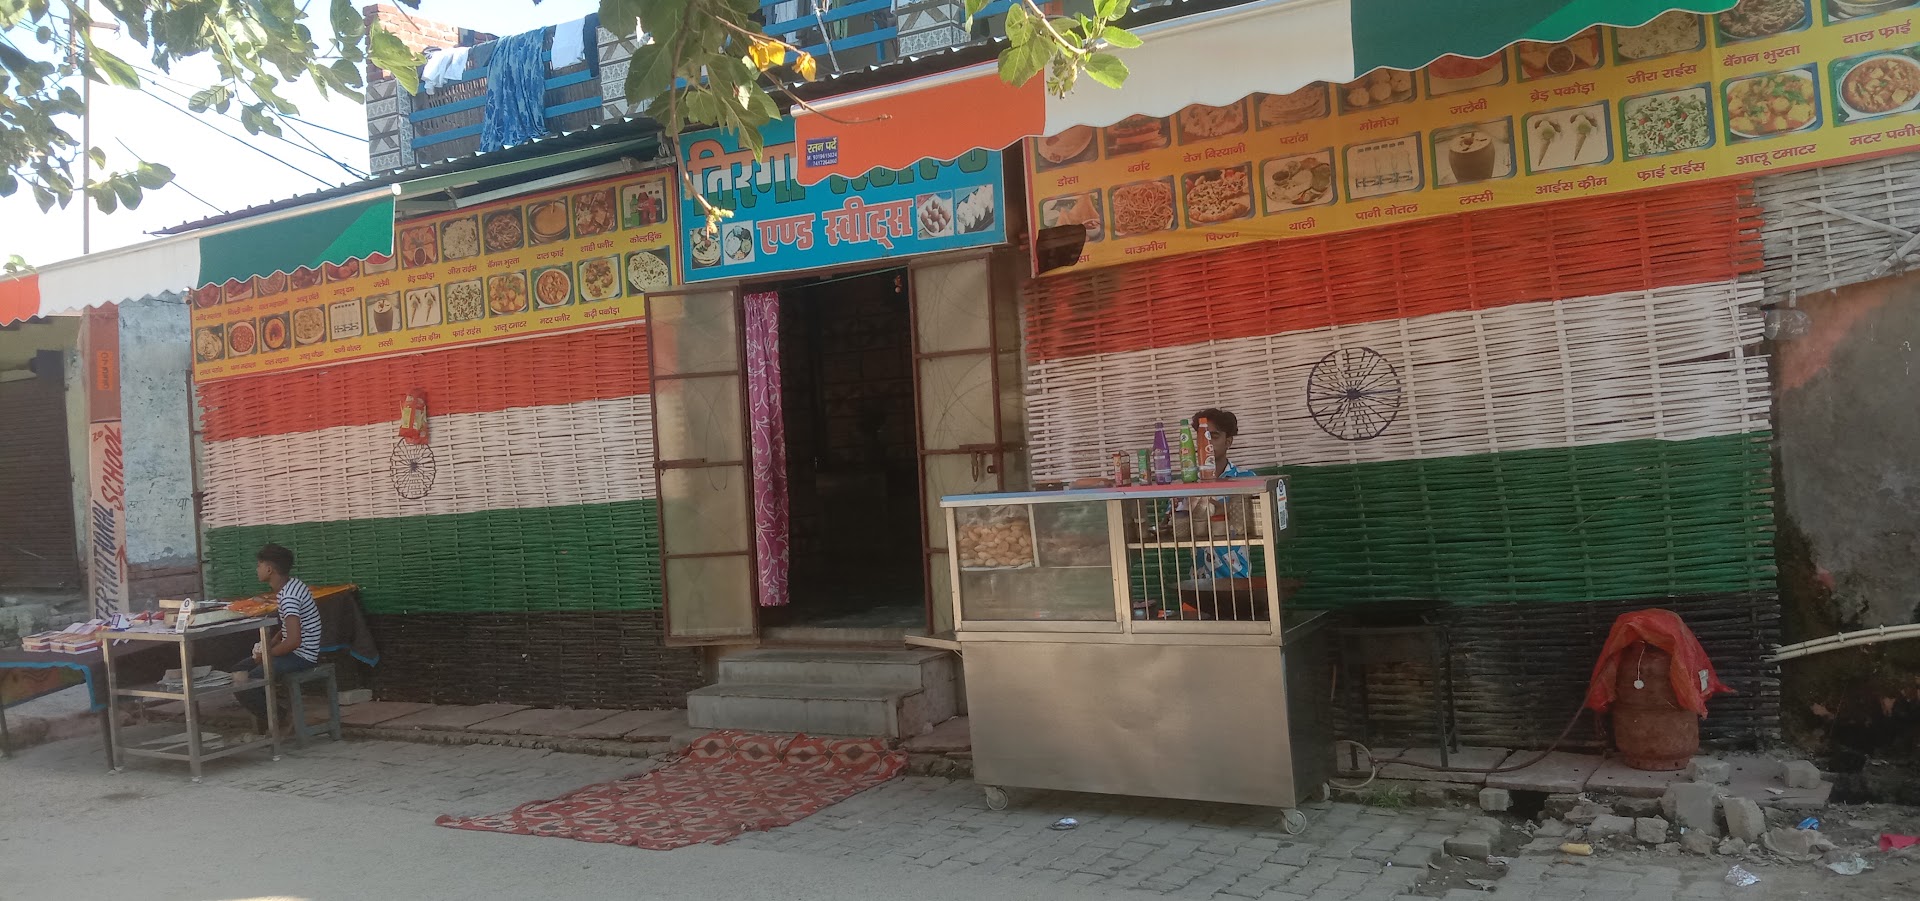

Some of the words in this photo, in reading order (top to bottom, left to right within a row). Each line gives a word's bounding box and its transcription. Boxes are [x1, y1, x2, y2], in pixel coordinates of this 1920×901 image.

[1843, 30, 1874, 44] दाल
[1879, 19, 1912, 39] फ्राई
[1764, 45, 1800, 64] भुरता
[1626, 71, 1658, 84] जीरा
[1662, 62, 1697, 78] राईस
[1450, 98, 1488, 115] जलेबी
[1360, 117, 1399, 132] मोमोज
[807, 142, 824, 153] रतन
[825, 137, 838, 150] पर्दे
[1849, 132, 1882, 146] मटर
[1183, 151, 1201, 163] वेज
[1736, 151, 1772, 166] आलू
[1772, 144, 1816, 160] टमाटर
[1127, 161, 1151, 174] बर्गर
[1637, 163, 1666, 181] फ्राई
[1669, 161, 1706, 176] राईस
[1057, 174, 1079, 187] डोसा
[1535, 179, 1574, 194] आईस
[1577, 175, 1608, 190] क्रीम
[1459, 190, 1494, 205] लस्सी
[1355, 206, 1381, 221] पानी
[1385, 202, 1418, 217] बोतल
[757, 213, 816, 255] एण्ड
[822, 195, 914, 250] स्वीट्स
[1288, 217, 1316, 231] थाली
[581, 242, 596, 253] शाही
[597, 240, 614, 249] पनीर
[1125, 240, 1167, 256] चाऊमीन
[536, 251, 549, 259] दाल
[447, 267, 461, 275] जीरा
[462, 264, 477, 273] राईस
[504, 258, 520, 268] भुरता
[540, 316, 553, 324] मटर
[554, 313, 571, 322] पनीर
[466, 326, 481, 336] राईस
[493, 322, 508, 332] आलू
[508, 320, 527, 329] टमाटर
[378, 338, 394, 348] लस्सी
[410, 334, 426, 343] आईस
[101, 424, 125, 512] SCHOOL
